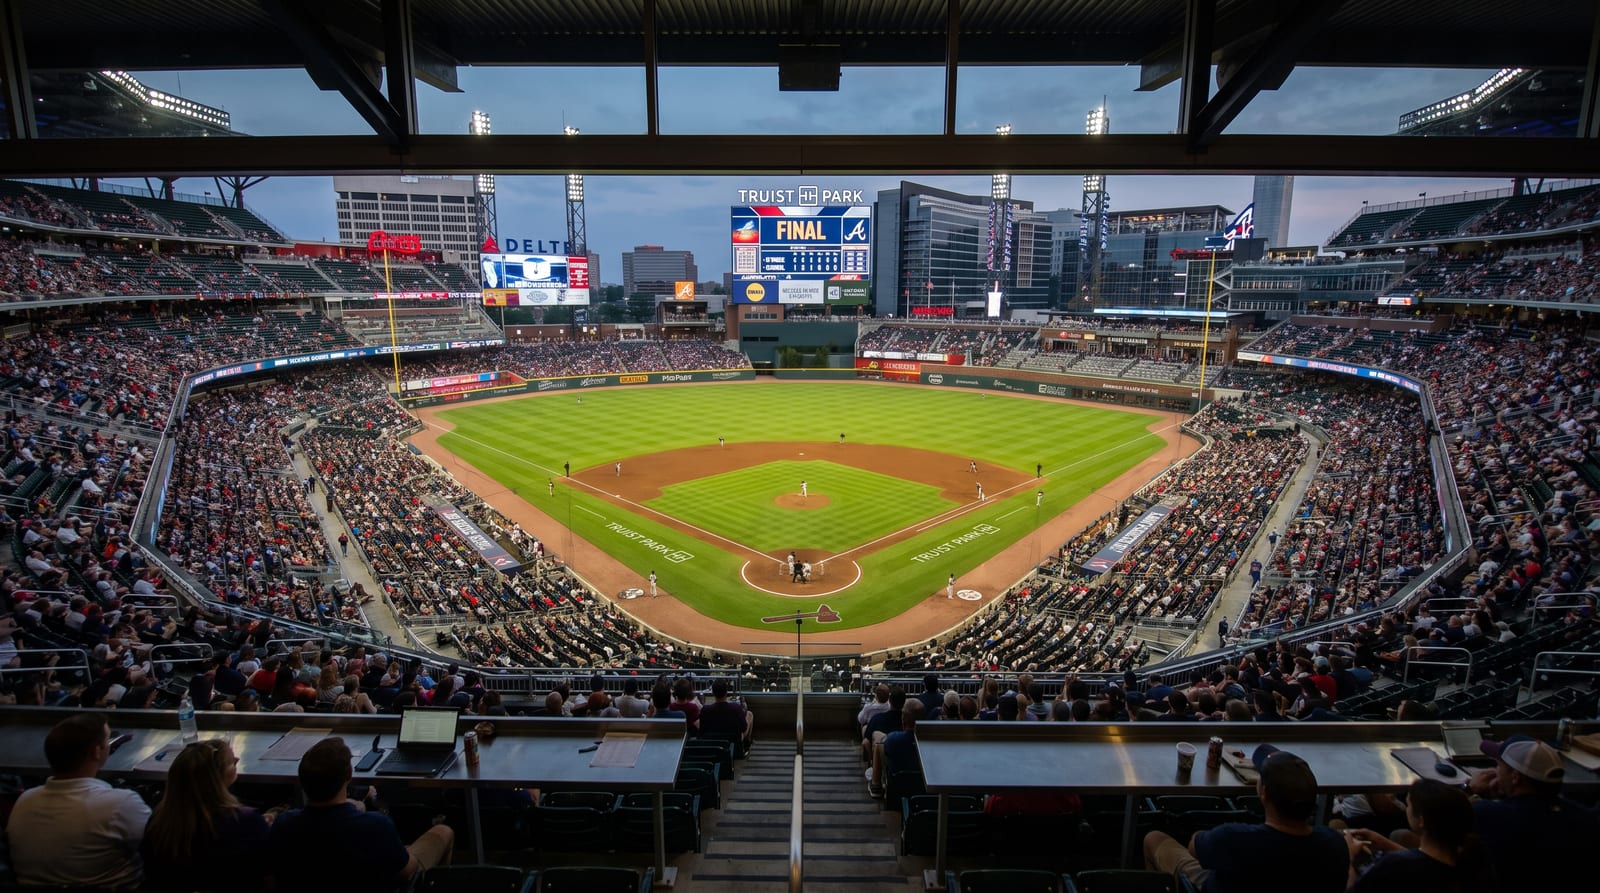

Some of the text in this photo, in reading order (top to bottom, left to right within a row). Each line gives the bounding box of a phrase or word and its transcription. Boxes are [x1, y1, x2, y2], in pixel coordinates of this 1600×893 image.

[738, 190, 863, 203] TRUIST PARK
[776, 220, 827, 240] FINAL
[605, 522, 674, 555] TRUIST PARK
[910, 530, 984, 563] TRUIST PARK
